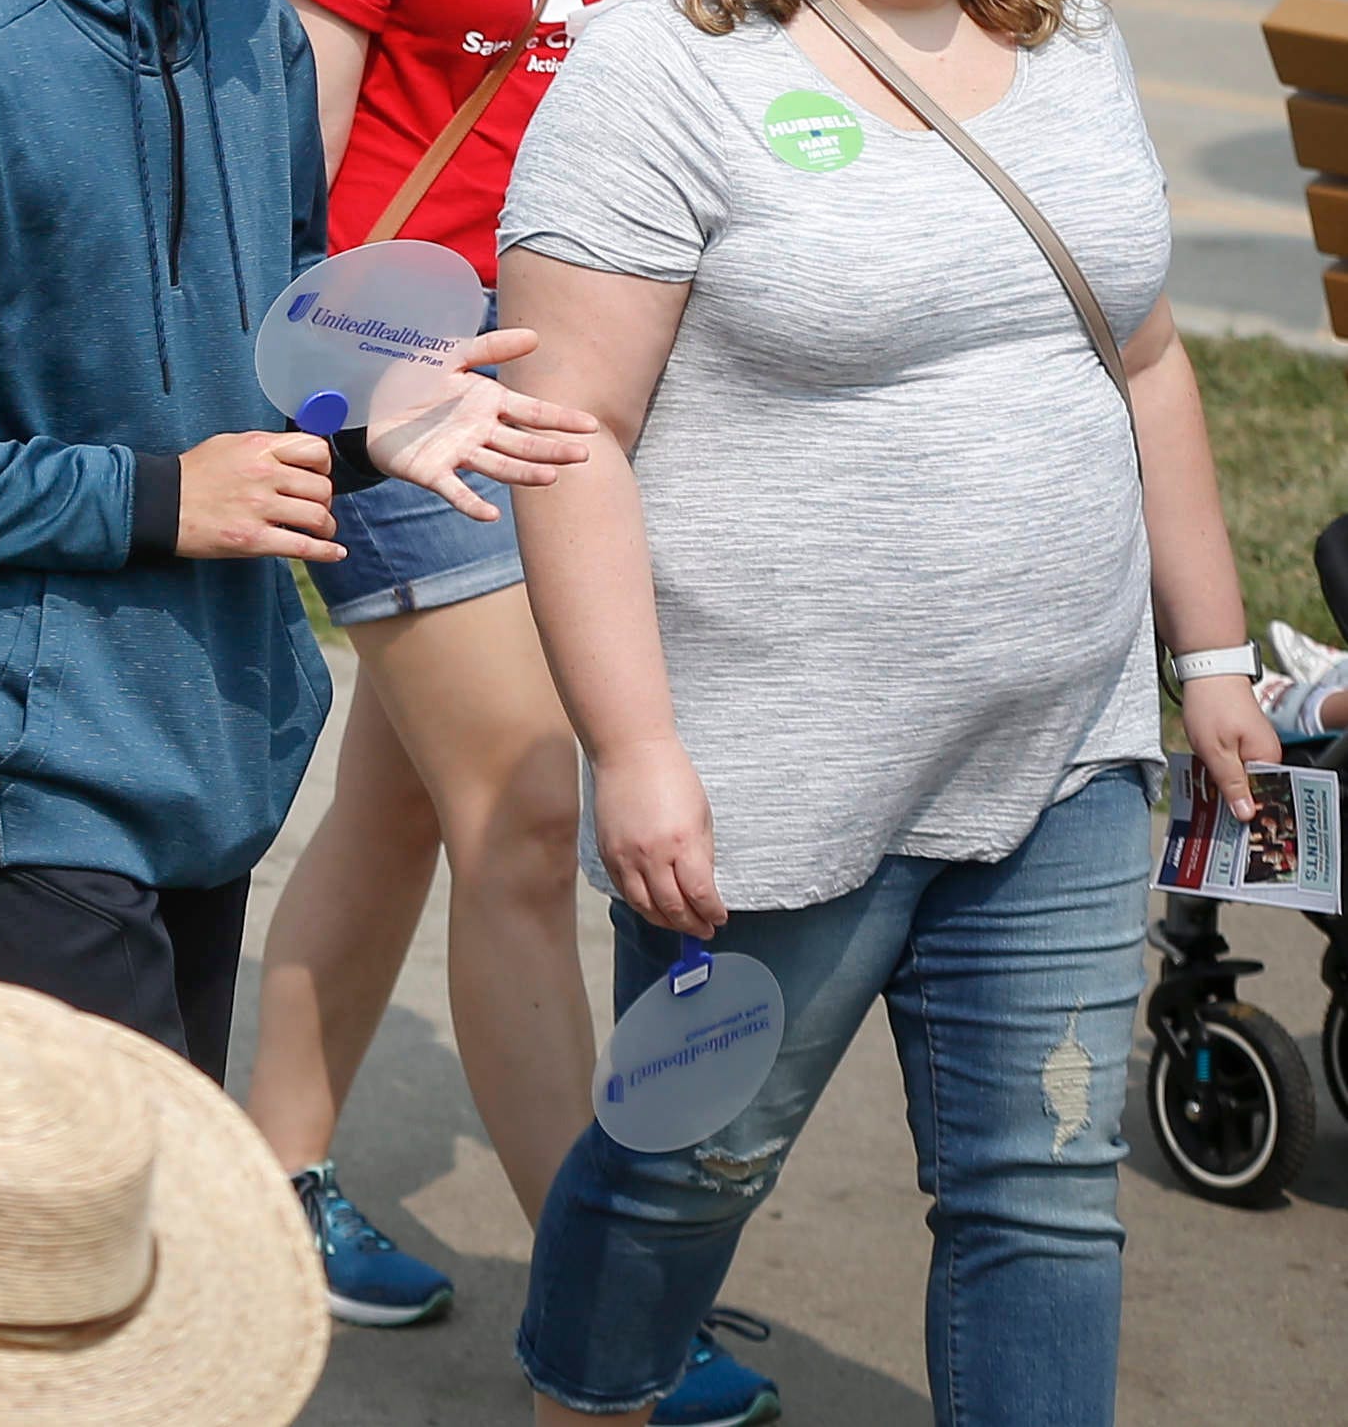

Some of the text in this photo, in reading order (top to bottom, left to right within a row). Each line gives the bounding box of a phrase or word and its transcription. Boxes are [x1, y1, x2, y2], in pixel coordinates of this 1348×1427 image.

[767, 114, 856, 138] HUBBELL
[311, 306, 457, 354] UnitedHealthcare
[359, 341, 444, 368] Community Plan
[1304, 787, 1318, 882] MOMENTS
